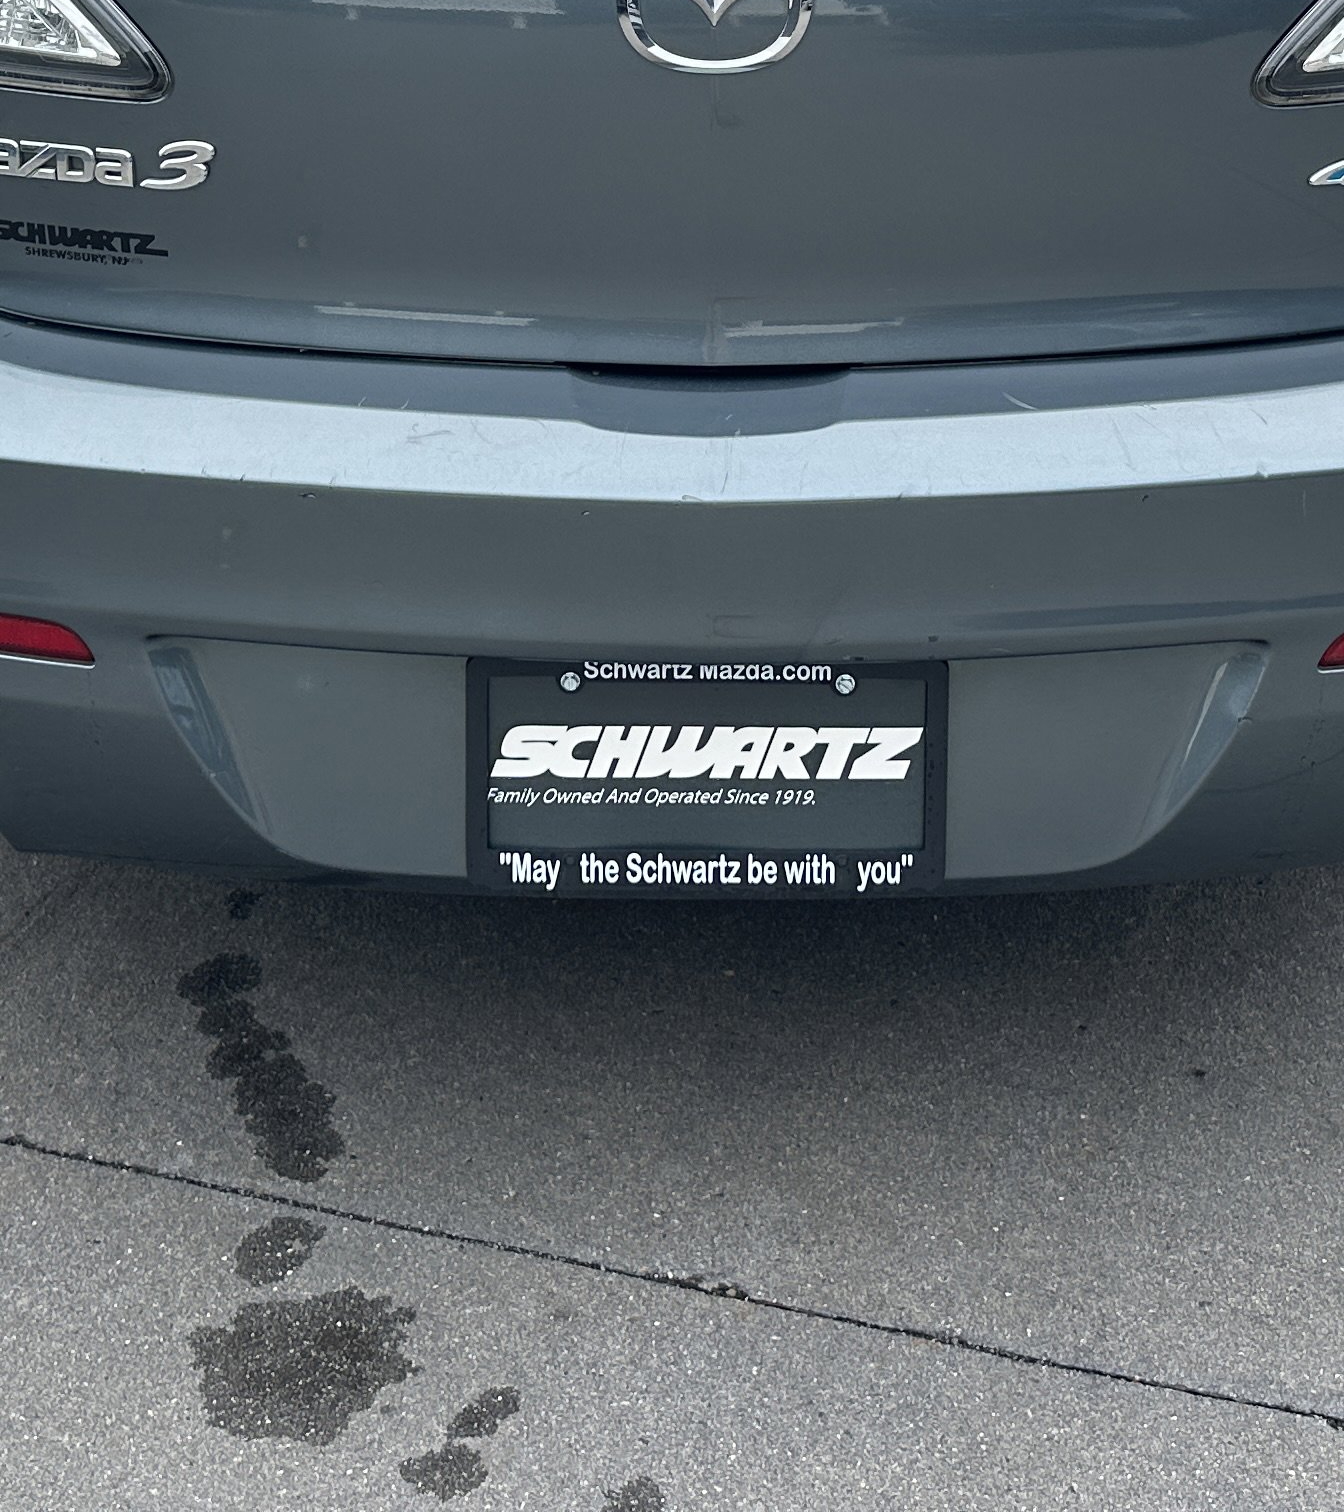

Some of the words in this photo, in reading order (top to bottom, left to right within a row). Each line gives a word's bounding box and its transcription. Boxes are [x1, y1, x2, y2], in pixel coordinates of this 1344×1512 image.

[139, 140, 215, 190] 3
[25, 246, 107, 265] SHREWSBURY,
[583, 661, 694, 680] Schwartz
[699, 664, 832, 681] Mazda.com
[490, 725, 924, 779] SCHWARTZ
[487, 787, 540, 807] Family
[543, 788, 605, 804] Owned
[606, 788, 643, 804] And
[644, 788, 723, 807] Operated
[724, 789, 769, 805] Since
[774, 790, 816, 805] 1919.
[580, 852, 619, 884] the
[626, 852, 742, 884] Schwartz
[747, 853, 778, 885] be
[784, 854, 836, 885] with
